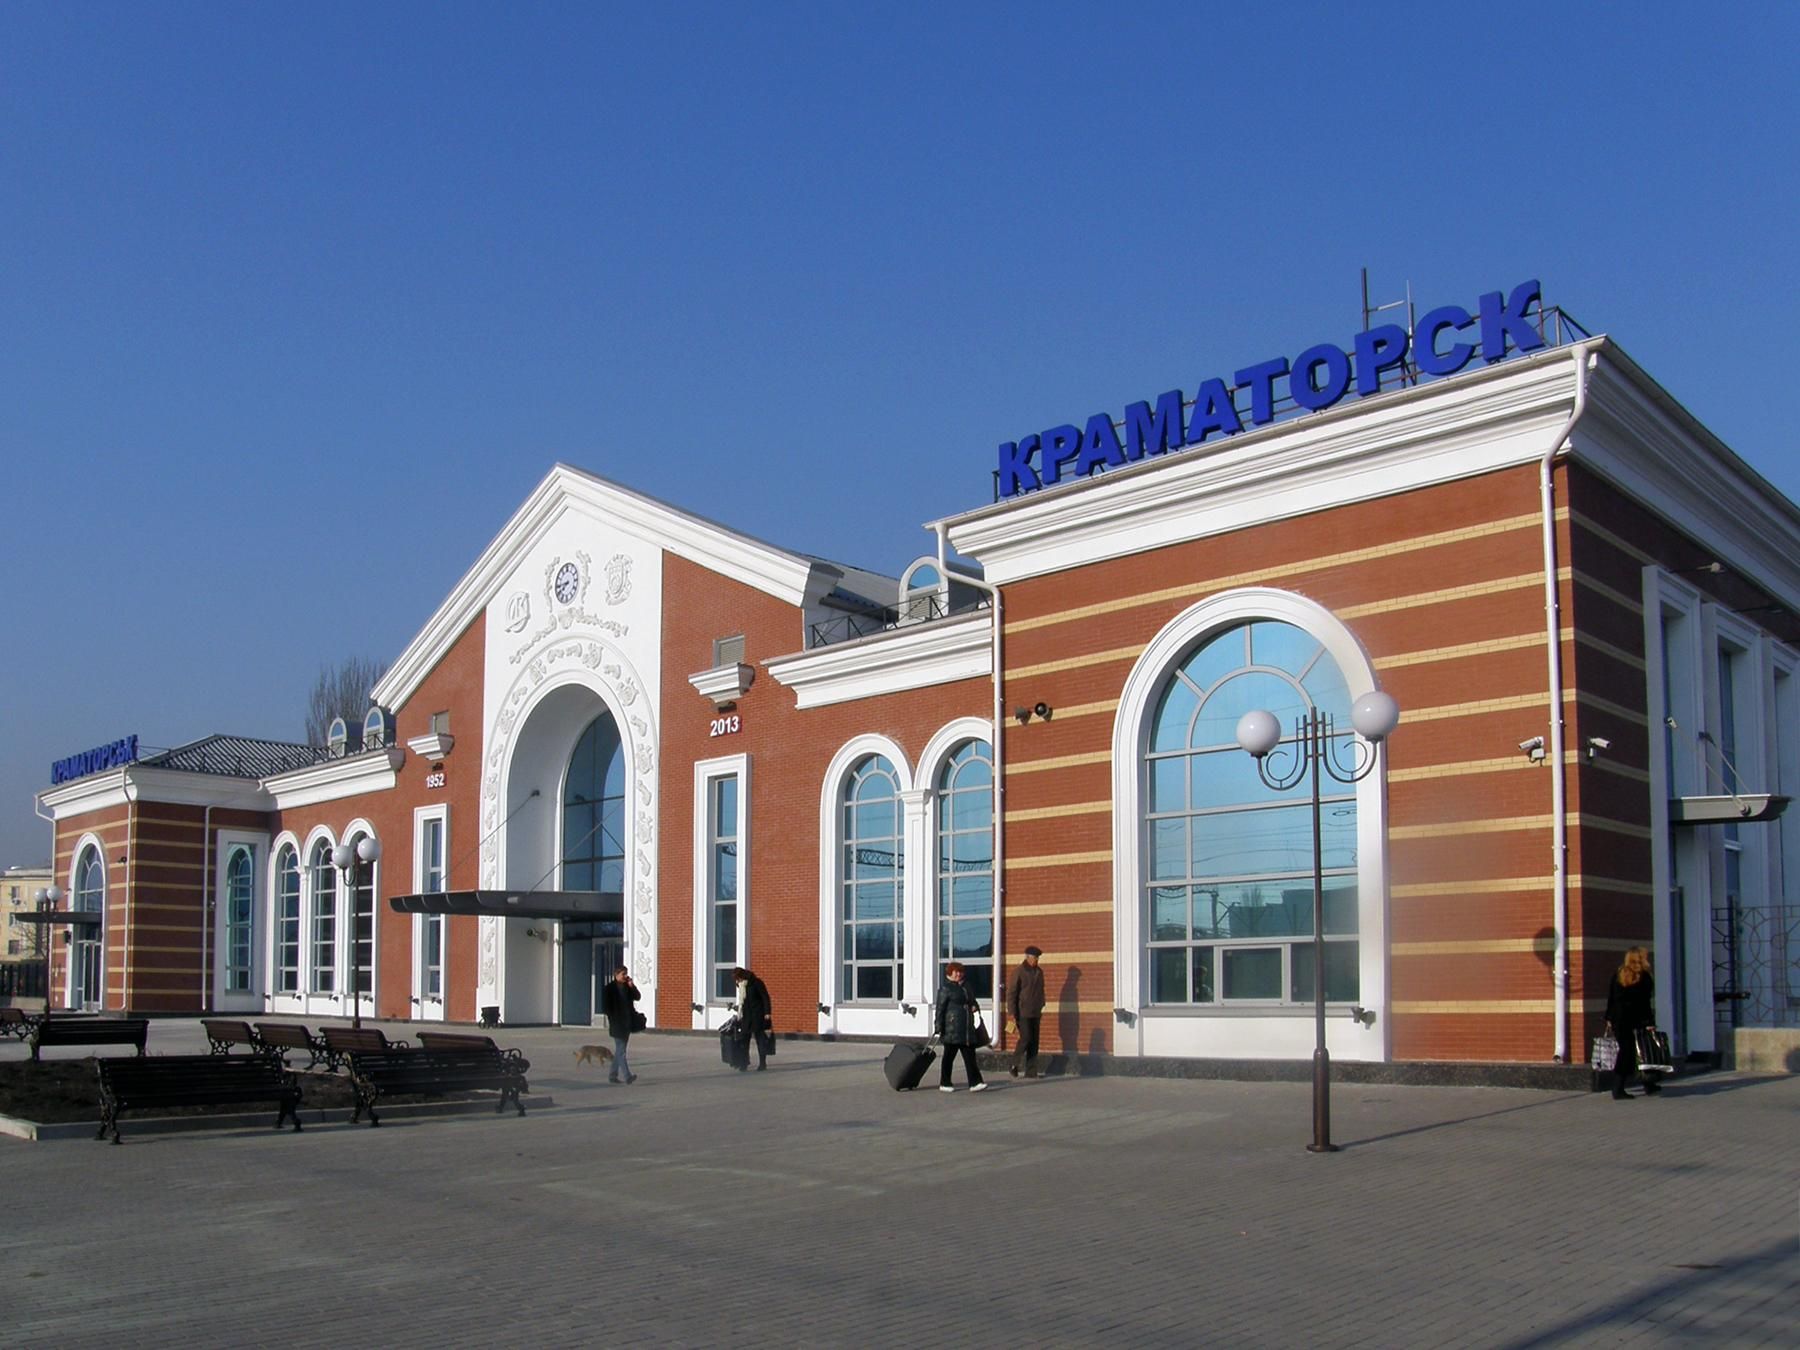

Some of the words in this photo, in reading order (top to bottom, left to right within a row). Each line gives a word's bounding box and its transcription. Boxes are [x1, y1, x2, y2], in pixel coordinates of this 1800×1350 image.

[999, 279, 1545, 497] КРАМАТОРСК
[710, 716, 740, 736] 2013
[426, 773, 445, 789] 1952
